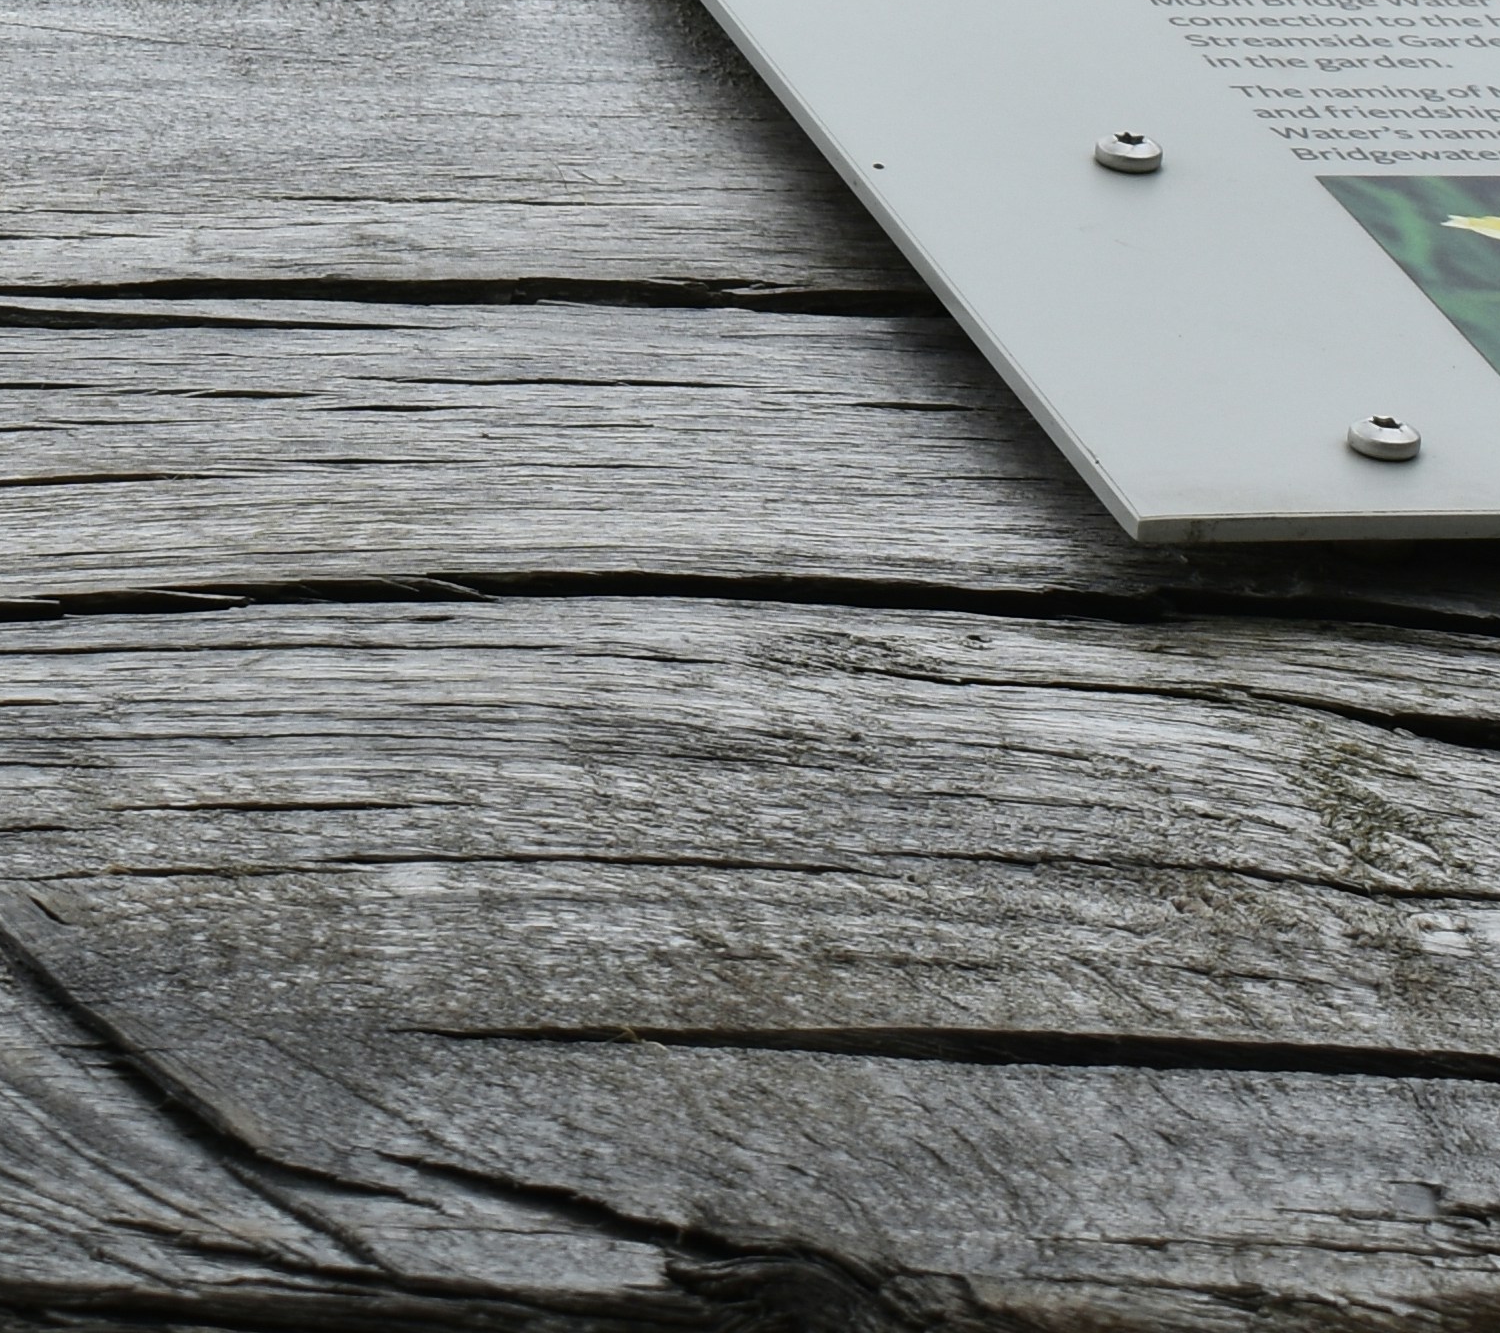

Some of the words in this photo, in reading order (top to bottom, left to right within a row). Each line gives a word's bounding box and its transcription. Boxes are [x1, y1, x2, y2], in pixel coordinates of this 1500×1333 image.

[1168, 14, 1372, 27] connection
[1375, 16, 1416, 27] to
[1420, 14, 1483, 27] the
[1184, 34, 1393, 48] Streamside
[1202, 54, 1242, 68] in
[1244, 54, 1309, 68] the
[1314, 54, 1453, 72] garden.
[1228, 85, 1304, 98] The
[1309, 85, 1446, 102] naming
[1446, 84, 1481, 98] of
[1252, 105, 1322, 119] and
